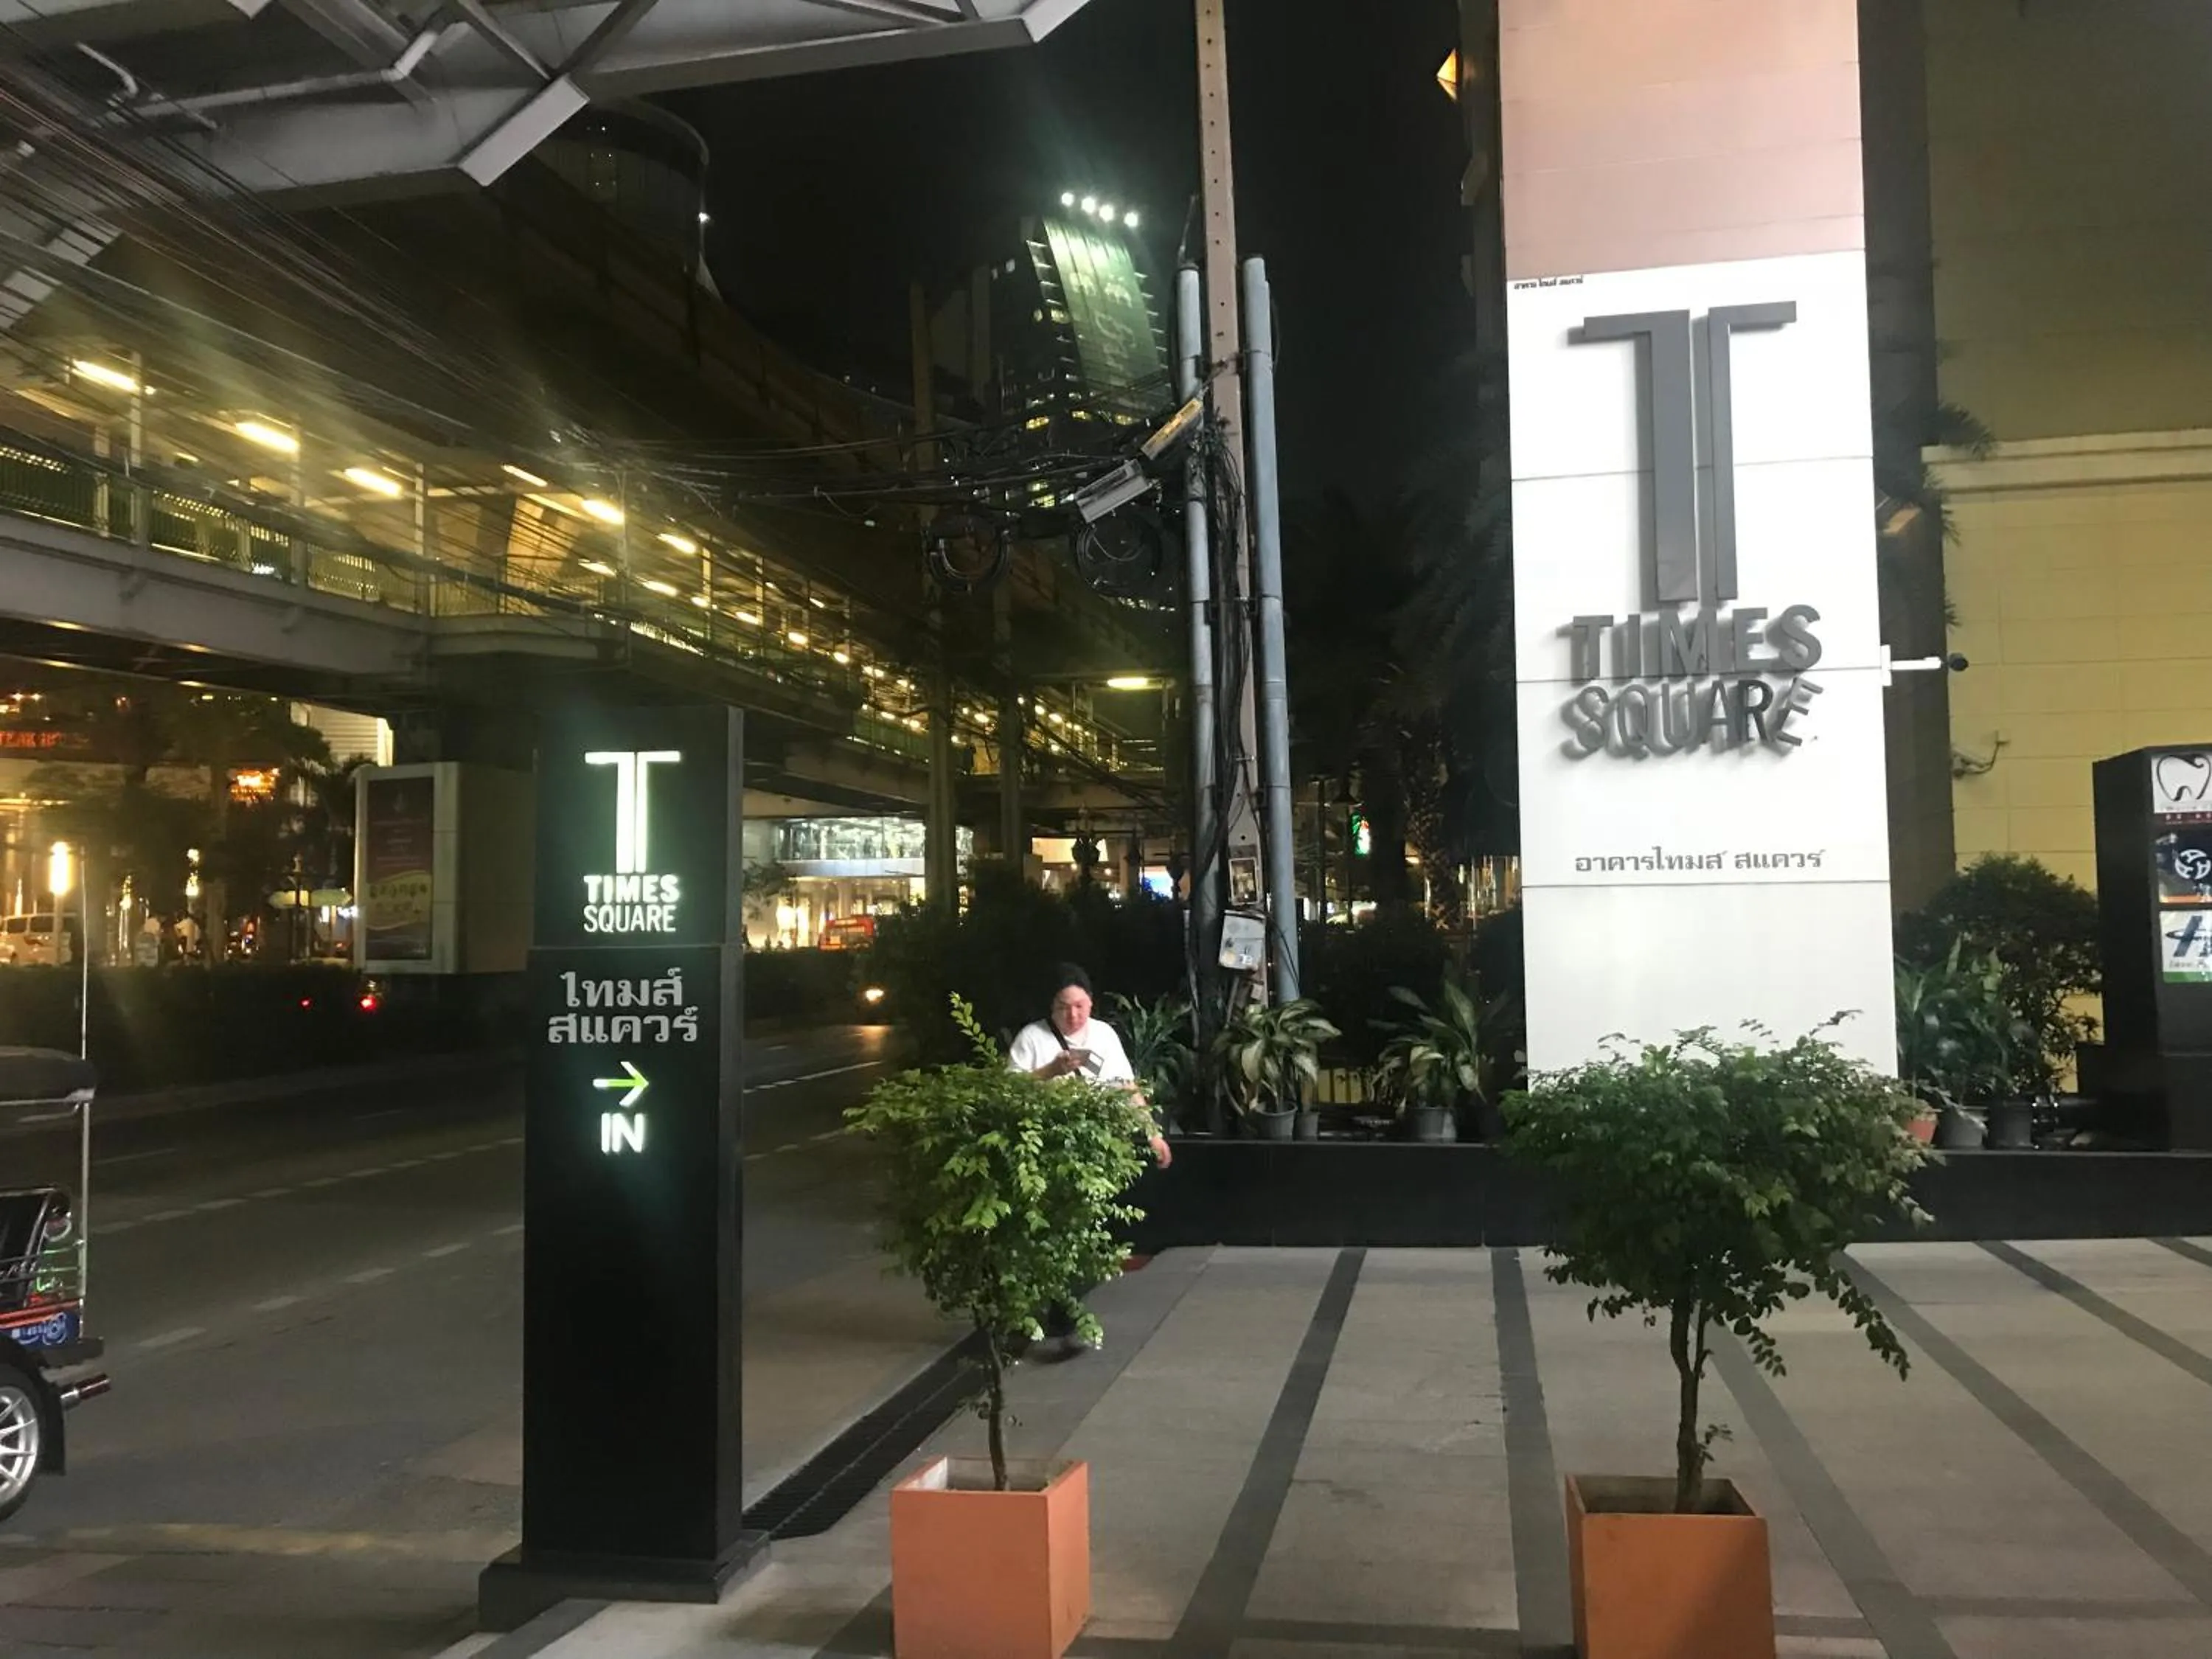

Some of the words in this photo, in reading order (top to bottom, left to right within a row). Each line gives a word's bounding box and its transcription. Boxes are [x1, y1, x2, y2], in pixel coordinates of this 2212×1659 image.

[1572, 604, 1823, 679] TIMES
[1575, 676, 1823, 752] SQUARE
[583, 874, 681, 904] TIMES
[583, 904, 677, 933] SQUARE
[560, 967, 683, 1007] ไทมส์
[548, 1006, 699, 1043] สแควร์
[600, 1113, 645, 1153] IN
